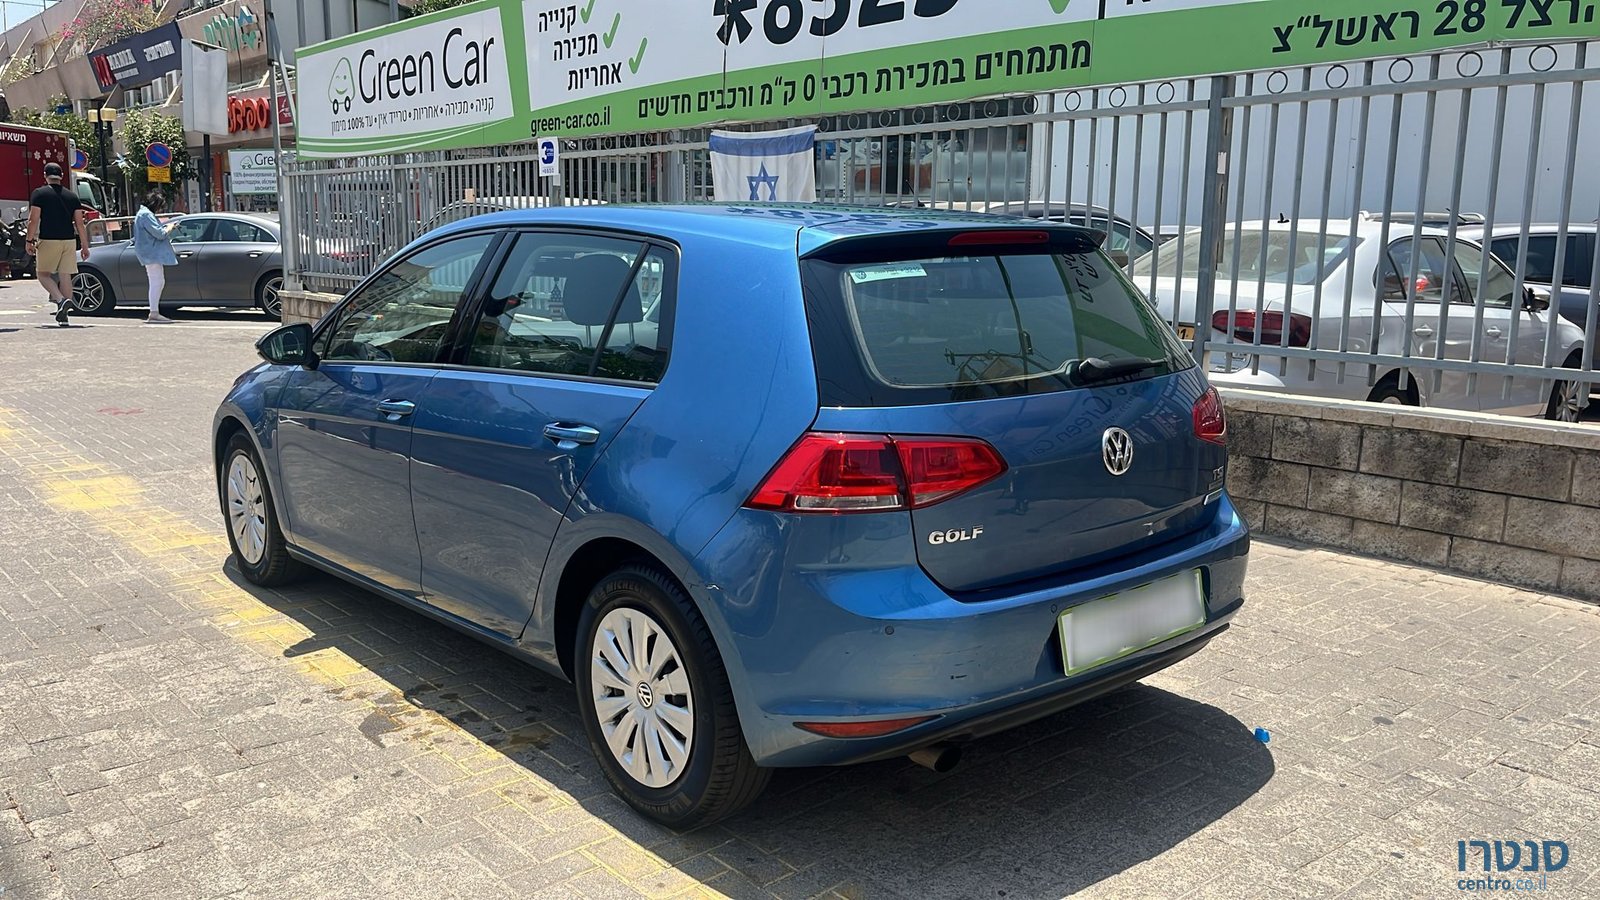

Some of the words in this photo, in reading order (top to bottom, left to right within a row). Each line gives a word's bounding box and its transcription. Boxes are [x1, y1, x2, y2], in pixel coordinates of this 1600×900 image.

[538, 4, 577, 33] קנייה
[1434, 0, 1485, 36] 28
[1501, 0, 1595, 28] רצל
[553, 33, 598, 62] מכירה
[975, 39, 1091, 80] מתמחים
[358, 49, 435, 104] Green
[442, 27, 495, 89] Car
[567, 61, 622, 91] אחריות
[875, 57, 966, 93] במכירת
[803, 74, 815, 102] 0
[822, 71, 868, 98] רכבי
[445, 100, 469, 116] מכירה
[475, 96, 494, 115] קניה
[638, 95, 692, 119] חדשים
[697, 84, 754, 113] ורכבים
[347, 116, 365, 131] 100%
[365, 115, 374, 128] עד
[377, 113, 388, 129] אין
[388, 110, 407, 124] טרייד
[413, 105, 439, 121] אחריות
[531, 106, 610, 137] green-car.co.il
[0, 131, 27, 143] משאיו
[331, 119, 347, 135] מימון
[254, 153, 276, 166] Gre
[928, 525, 984, 545] GOLF
